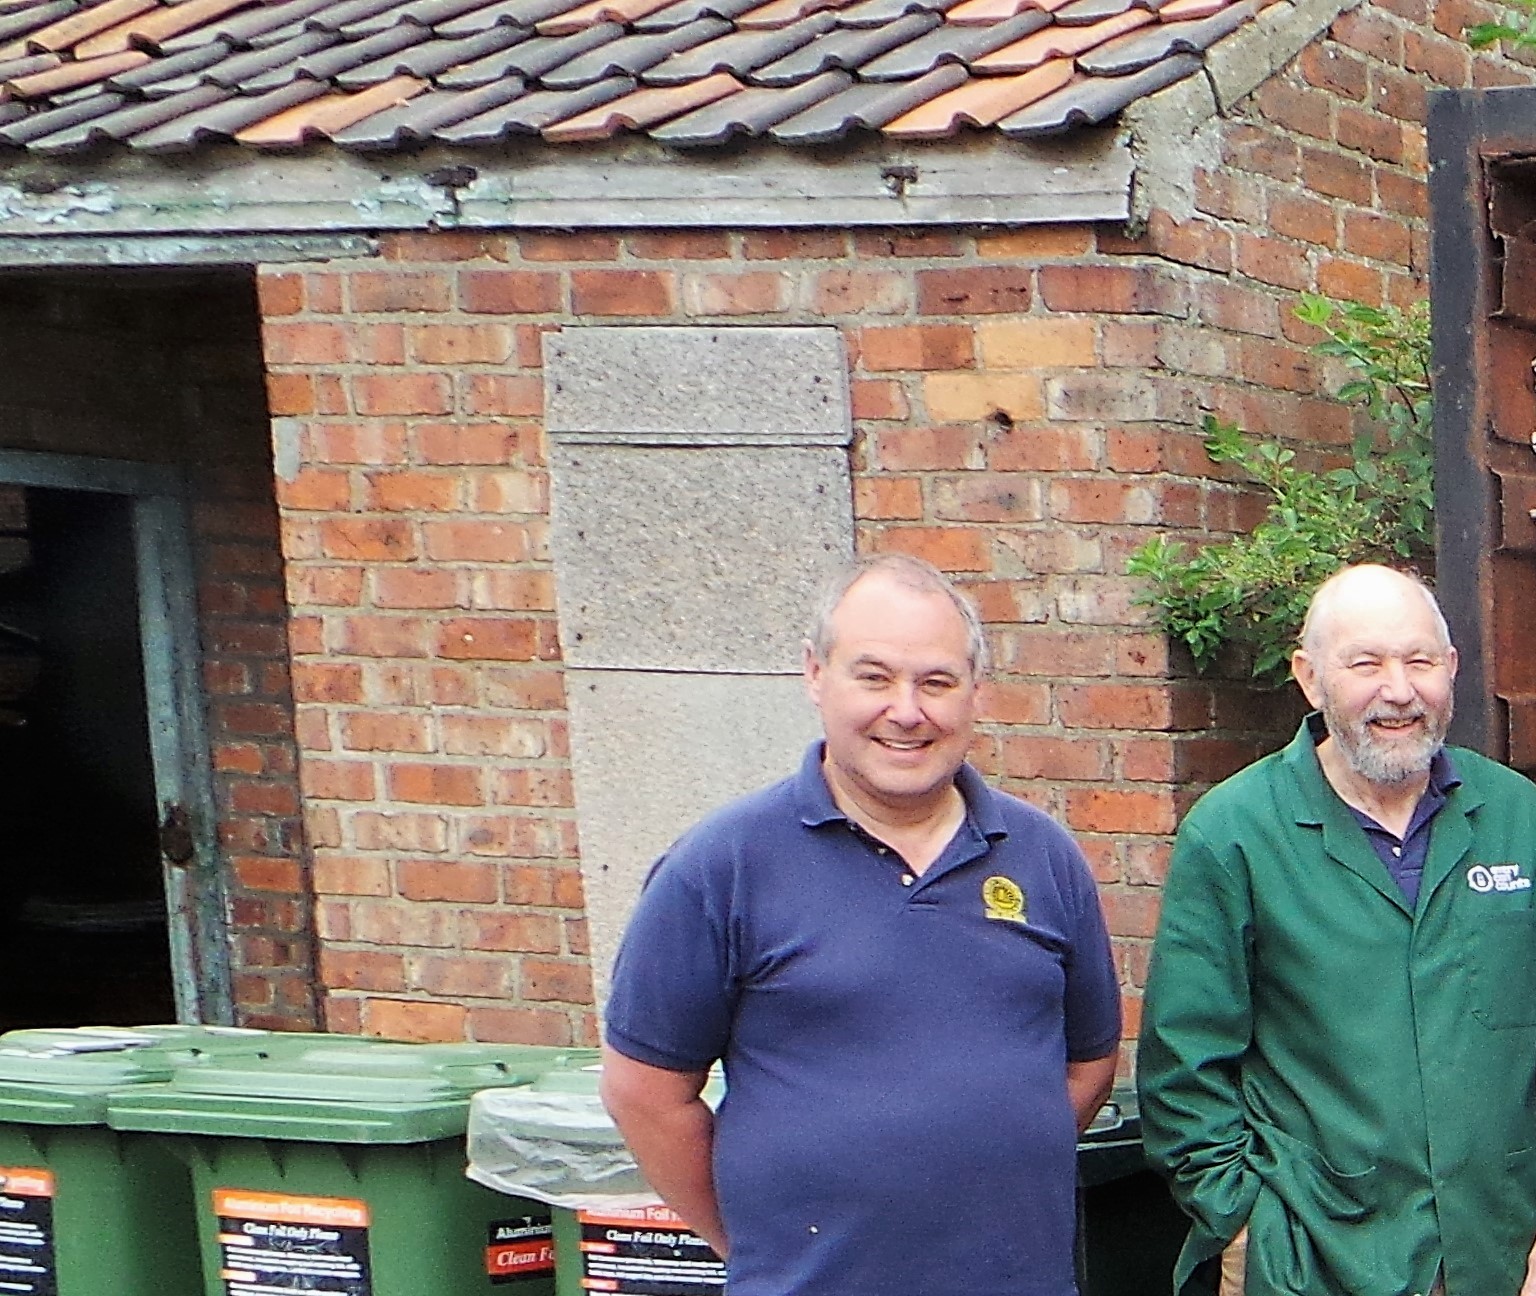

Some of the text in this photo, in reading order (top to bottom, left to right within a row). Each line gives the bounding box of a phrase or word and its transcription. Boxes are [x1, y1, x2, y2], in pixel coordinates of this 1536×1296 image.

[654, 1232, 678, 1248] Only
[497, 1246, 555, 1267] Clean Fo
